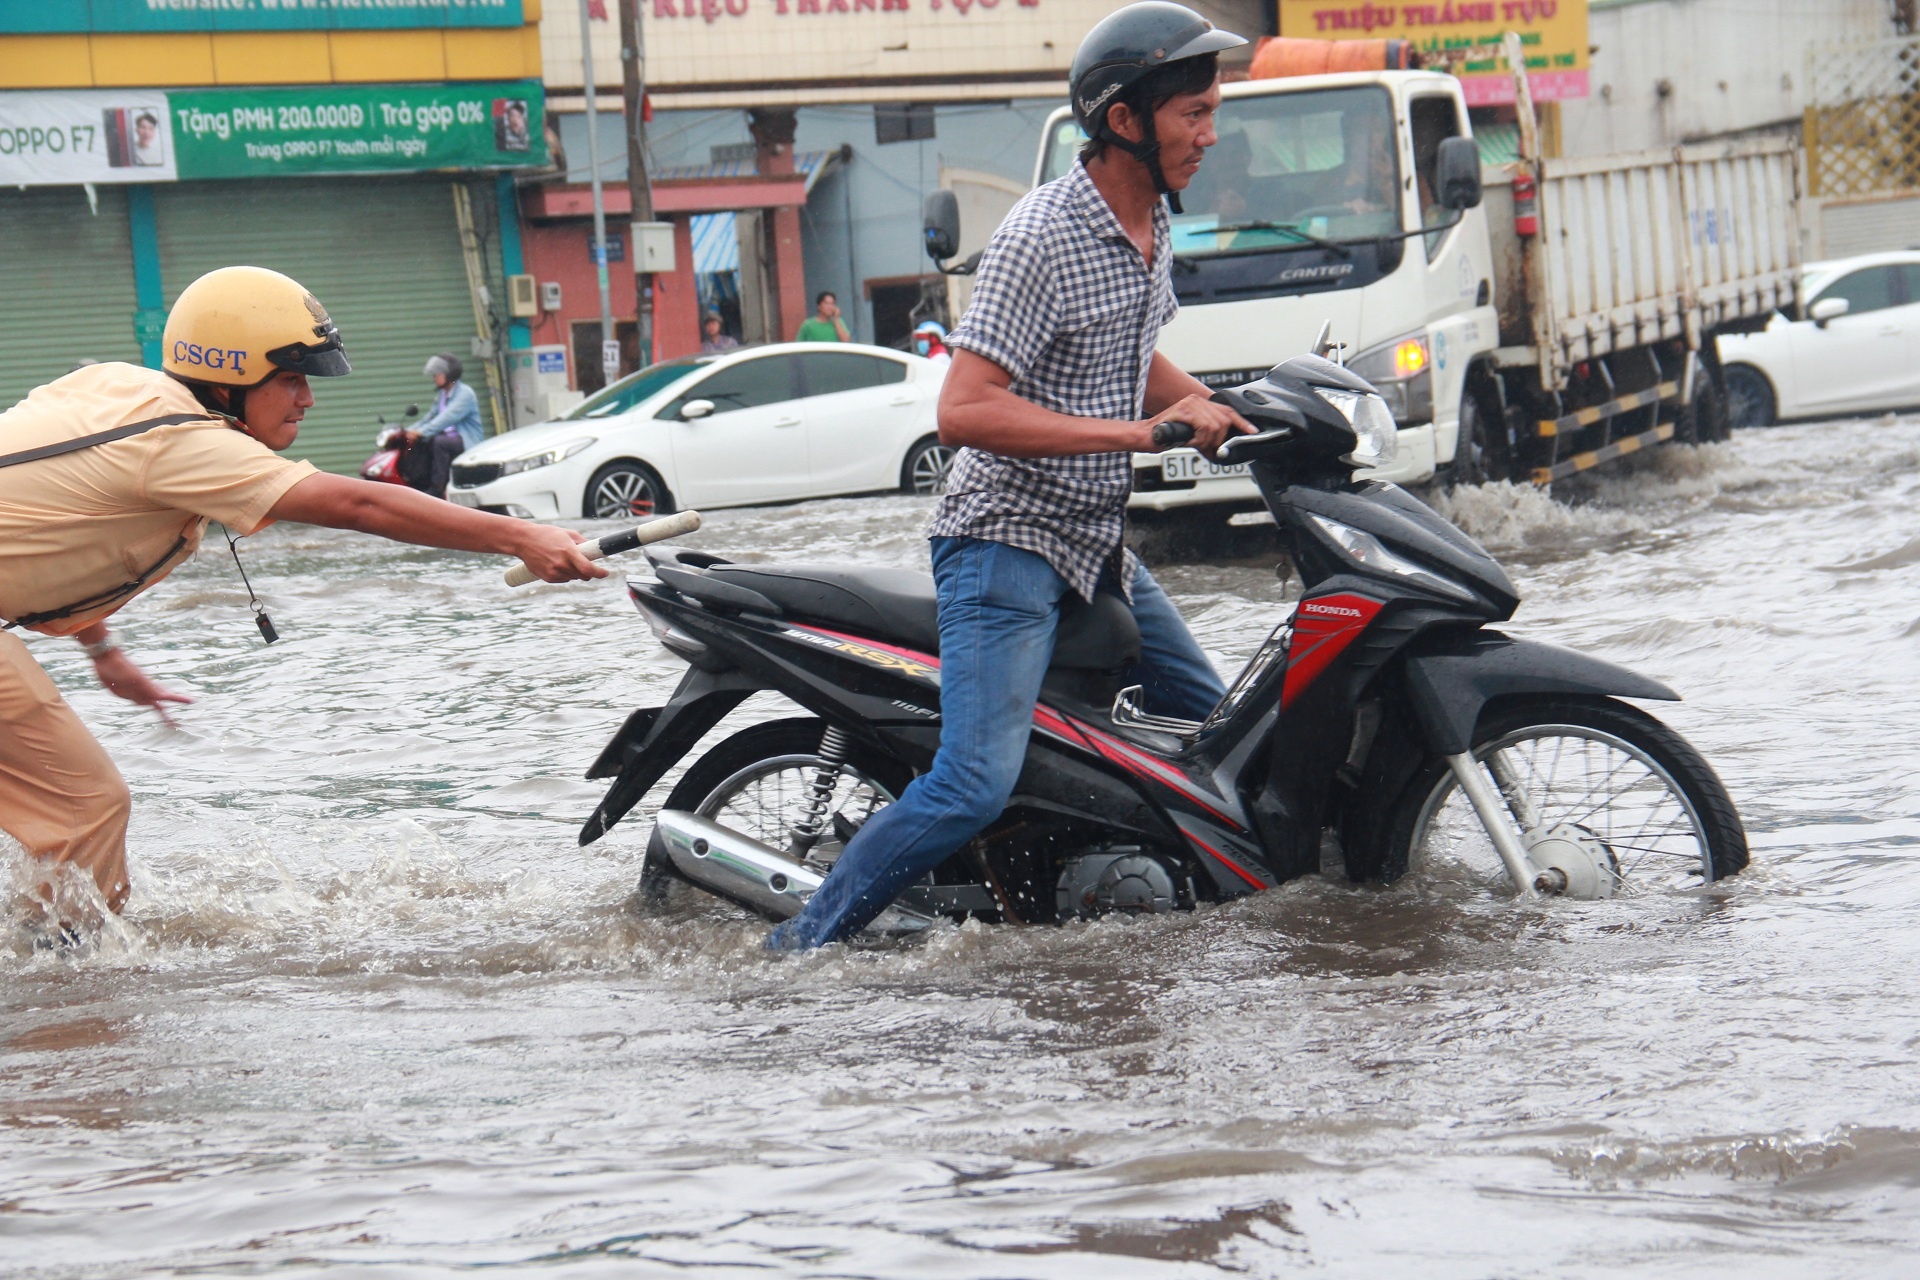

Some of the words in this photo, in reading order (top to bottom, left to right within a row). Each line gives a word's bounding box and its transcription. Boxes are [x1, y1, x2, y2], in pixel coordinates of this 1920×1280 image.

[177, 107, 230, 140] Tặng
[232, 107, 275, 132] PMH
[380, 100, 412, 126] Trả
[415, 100, 454, 132] góp
[457, 100, 484, 124] 0%
[0, 127, 65, 154] OPPO
[71, 125, 94, 153] F7
[283, 141, 317, 157] OPPO
[319, 140, 332, 155] F7
[333, 139, 369, 155] Youth
[1281, 264, 1354, 280] CANTER
[174, 340, 247, 371] CSGT
[1305, 603, 1362, 617] HONDA
[835, 643, 935, 677] RSX
